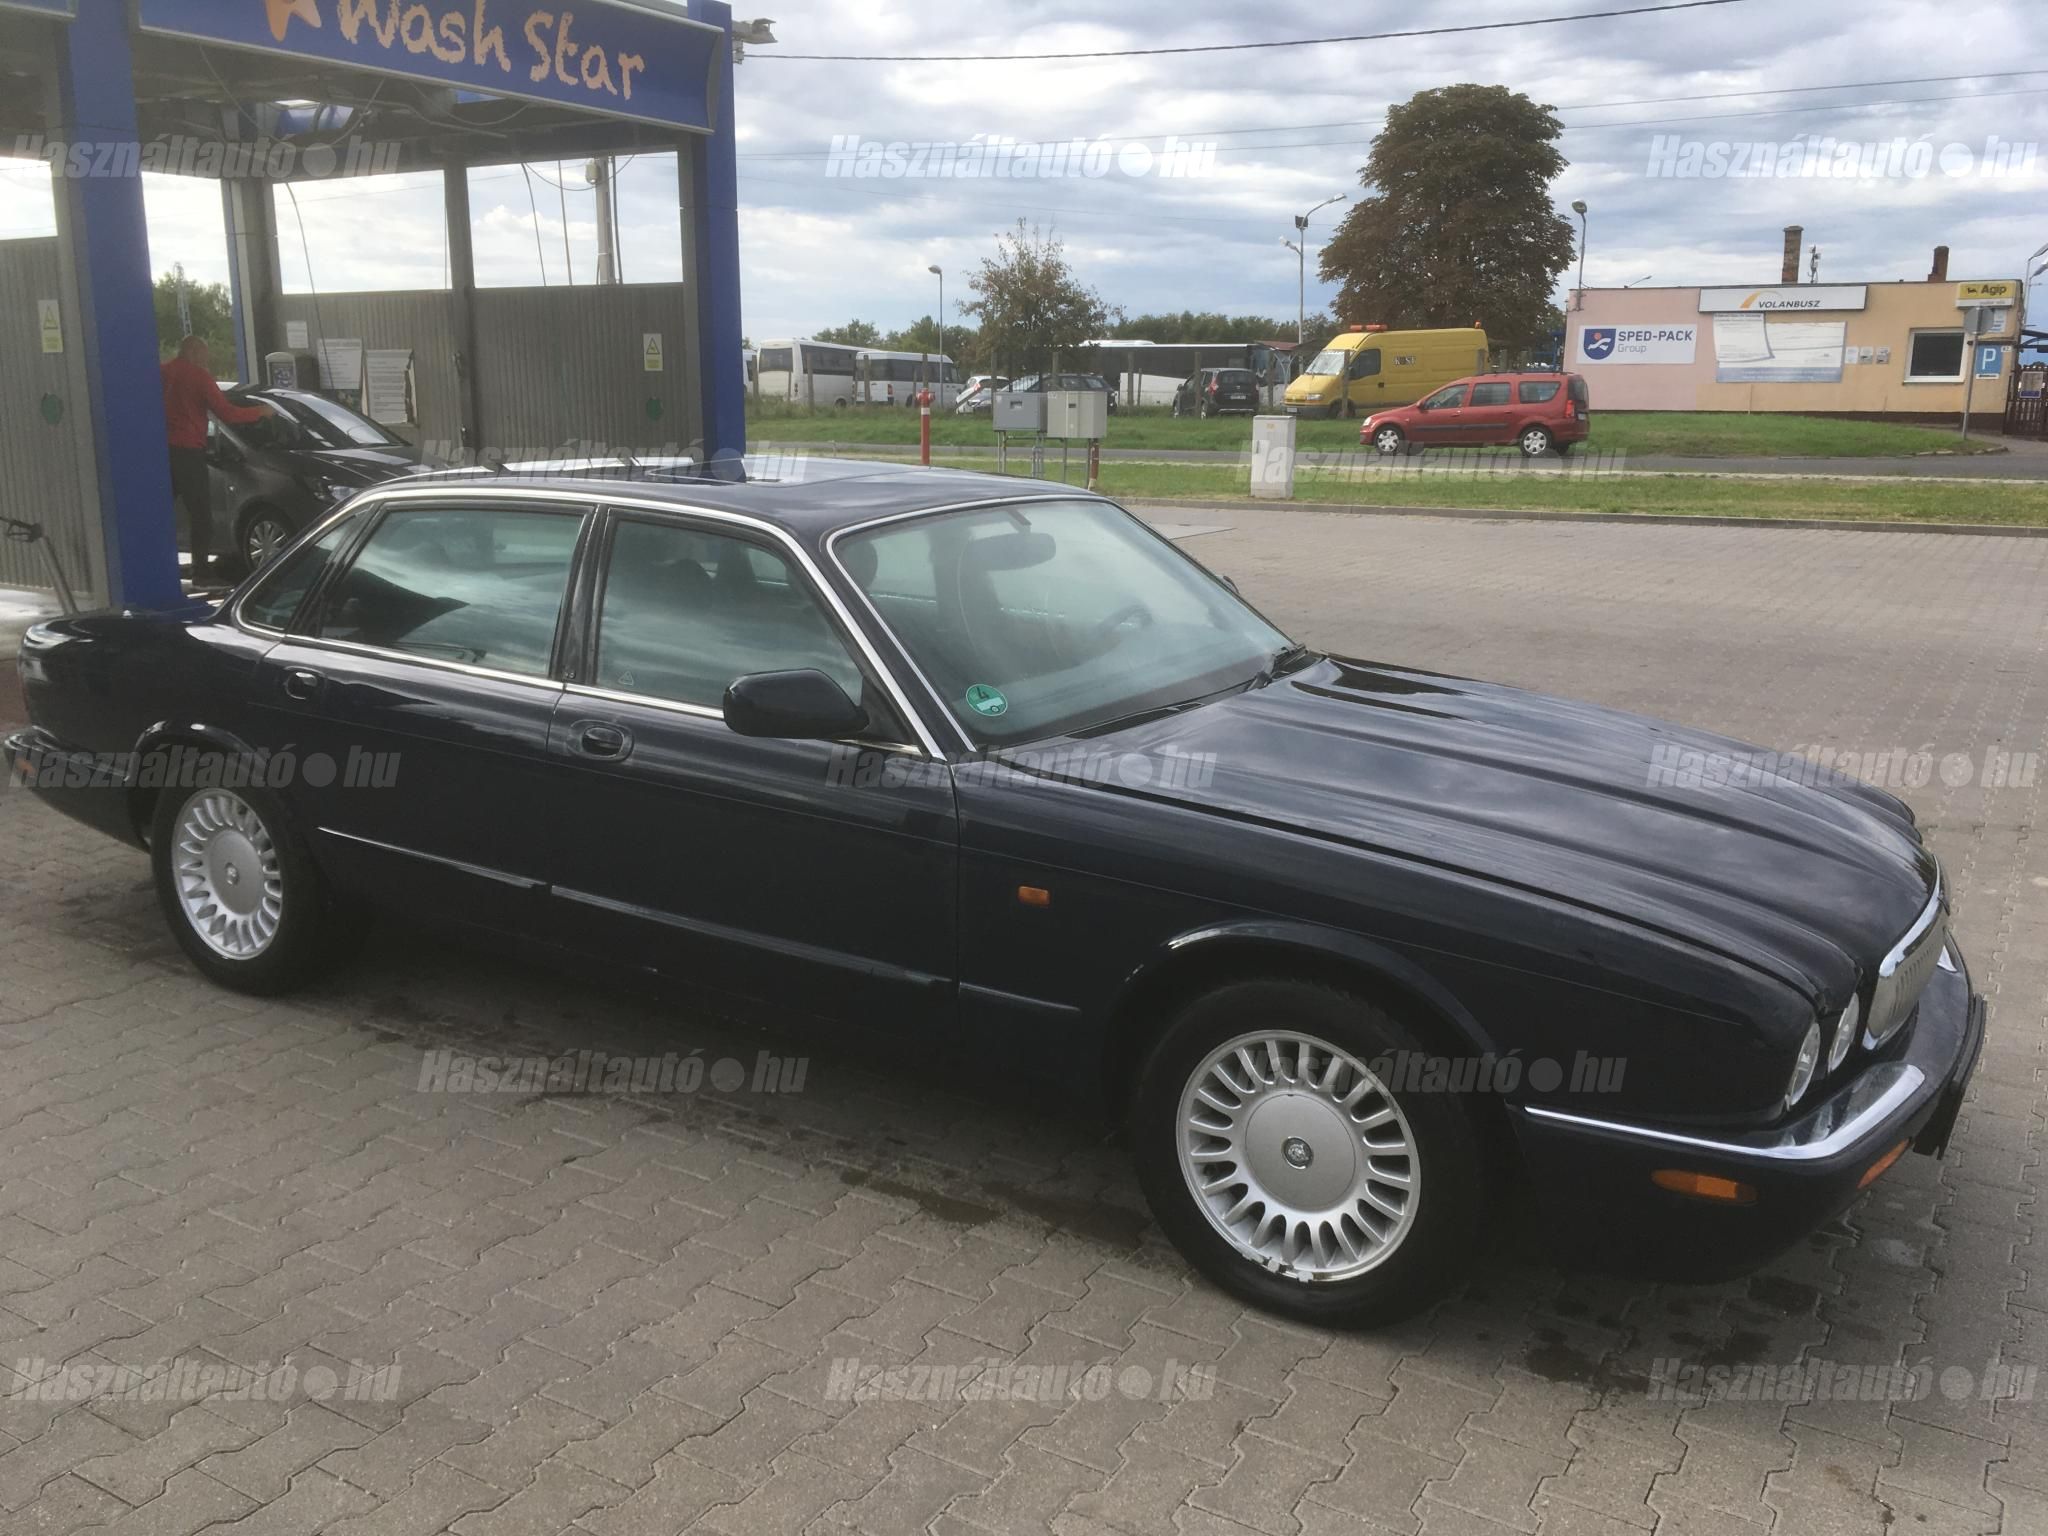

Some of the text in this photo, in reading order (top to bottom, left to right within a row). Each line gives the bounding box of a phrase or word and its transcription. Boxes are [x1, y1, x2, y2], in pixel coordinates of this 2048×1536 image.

[335, 0, 645, 99] Wash Star
[1981, 284, 2007, 296] Agip
[1618, 330, 1693, 342] SPED-PACK
[1618, 343, 1647, 354] Group
[1982, 348, 1996, 370] P
